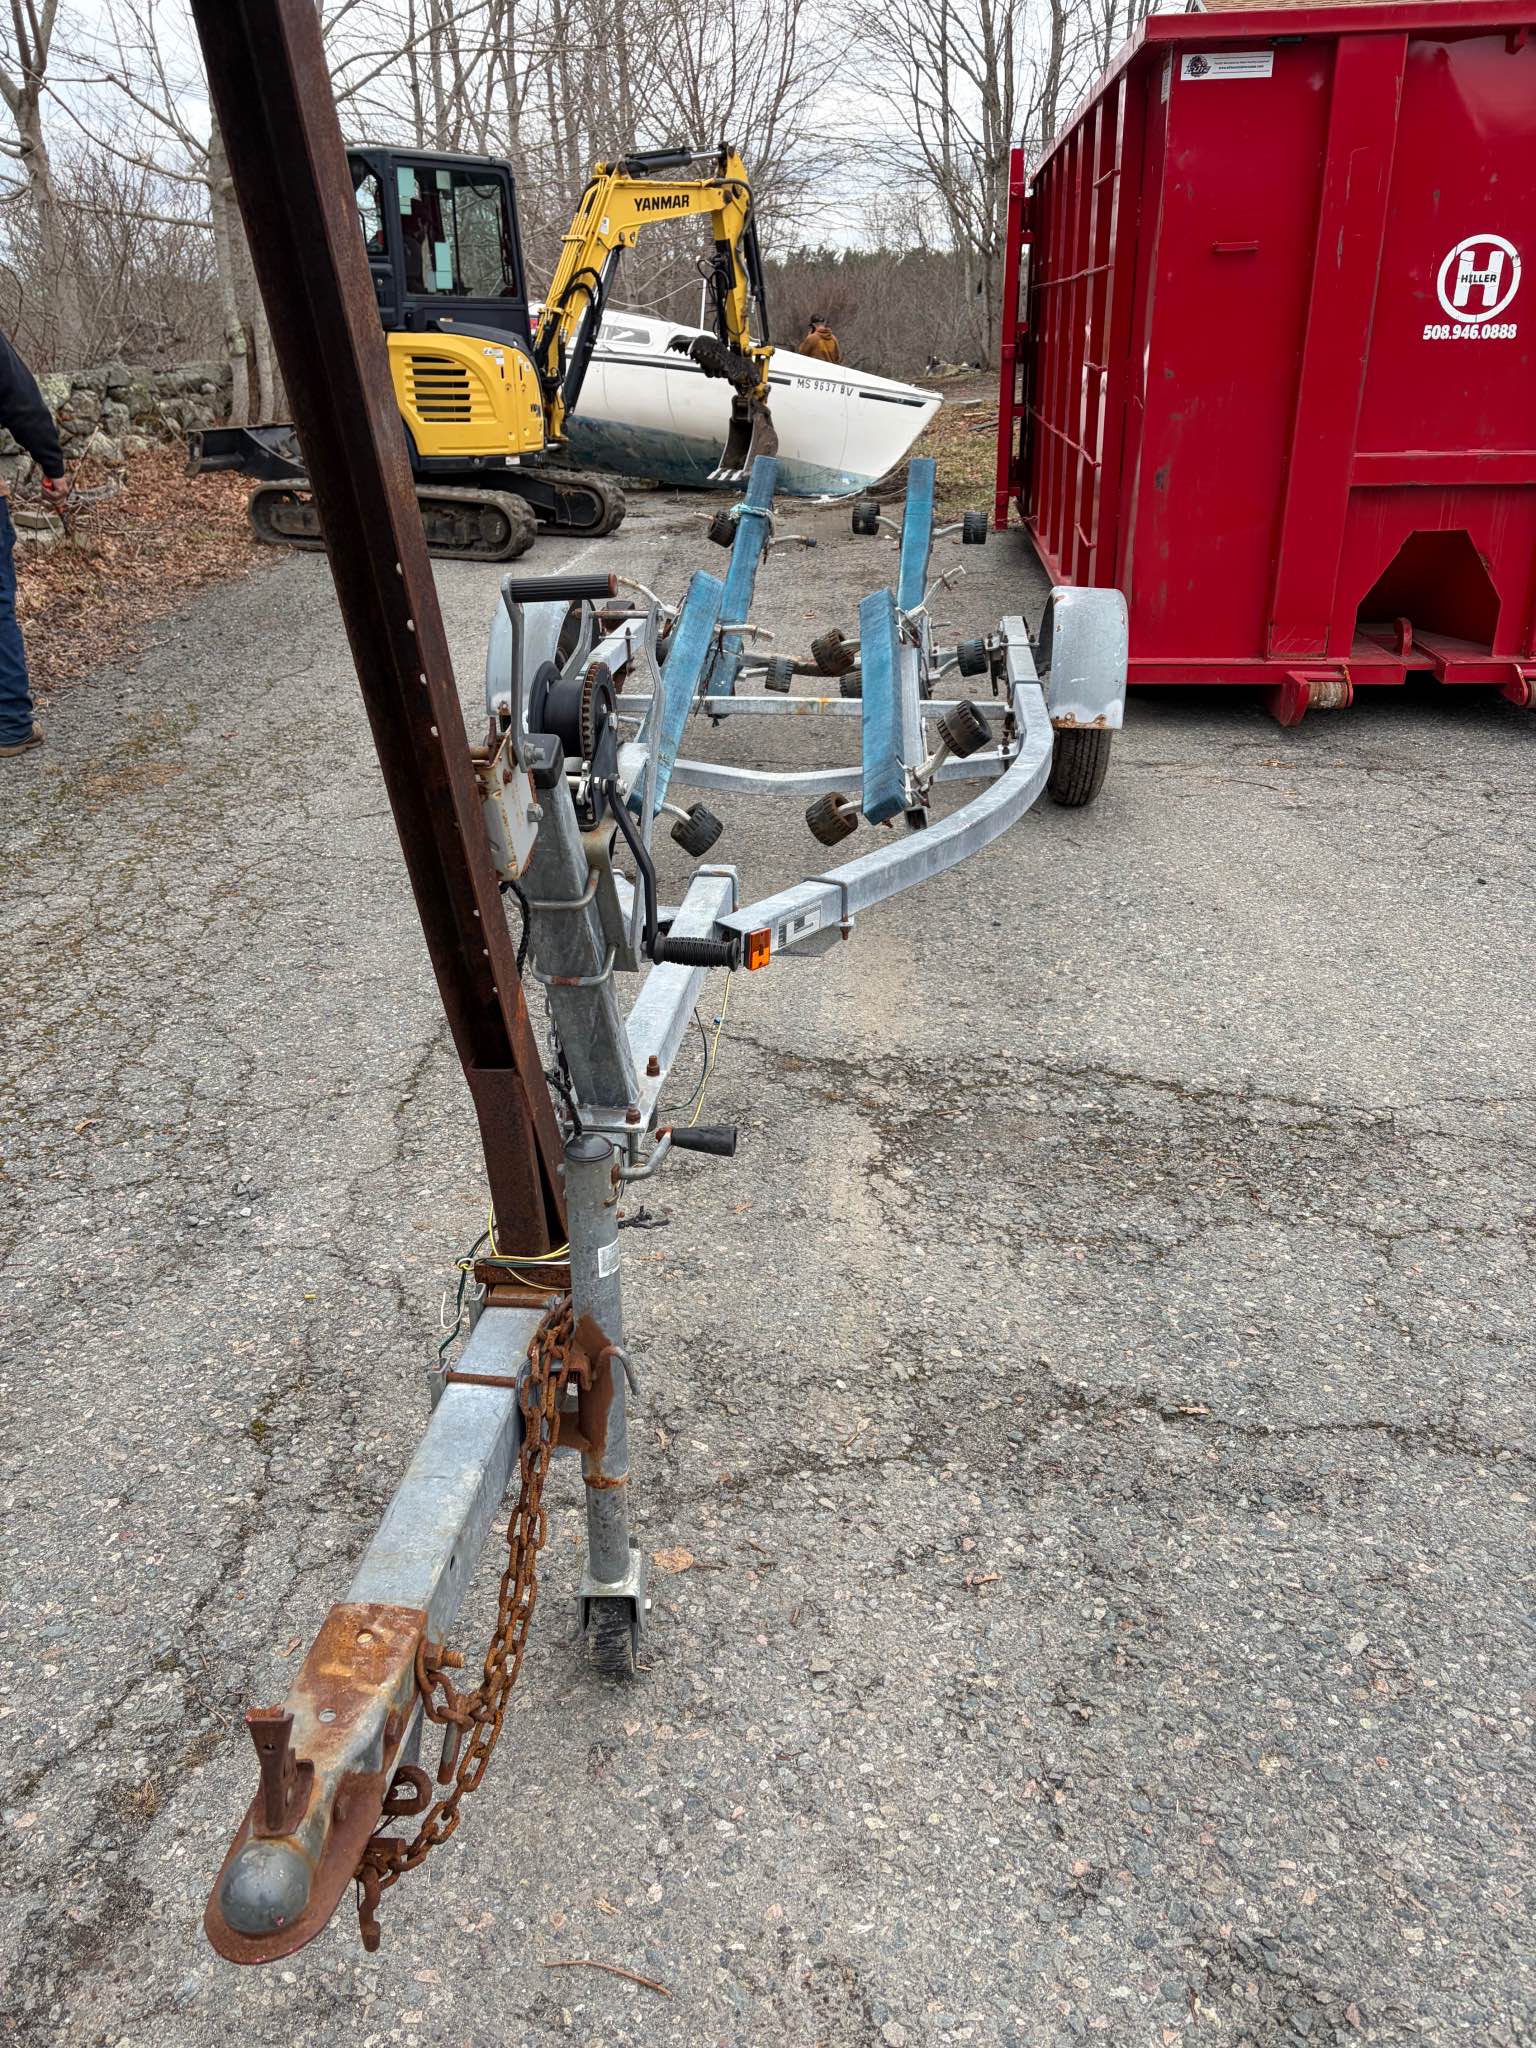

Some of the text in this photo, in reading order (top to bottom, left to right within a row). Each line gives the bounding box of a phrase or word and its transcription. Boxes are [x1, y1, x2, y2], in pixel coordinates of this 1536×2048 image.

[634, 194, 690, 212] YANMAR
[1453, 250, 1505, 307] H
[1460, 273, 1497, 284] HILLER
[1422, 323, 1518, 341] 508.946.0888
[797, 378, 811, 389] MS
[813, 380, 837, 393] 9637
